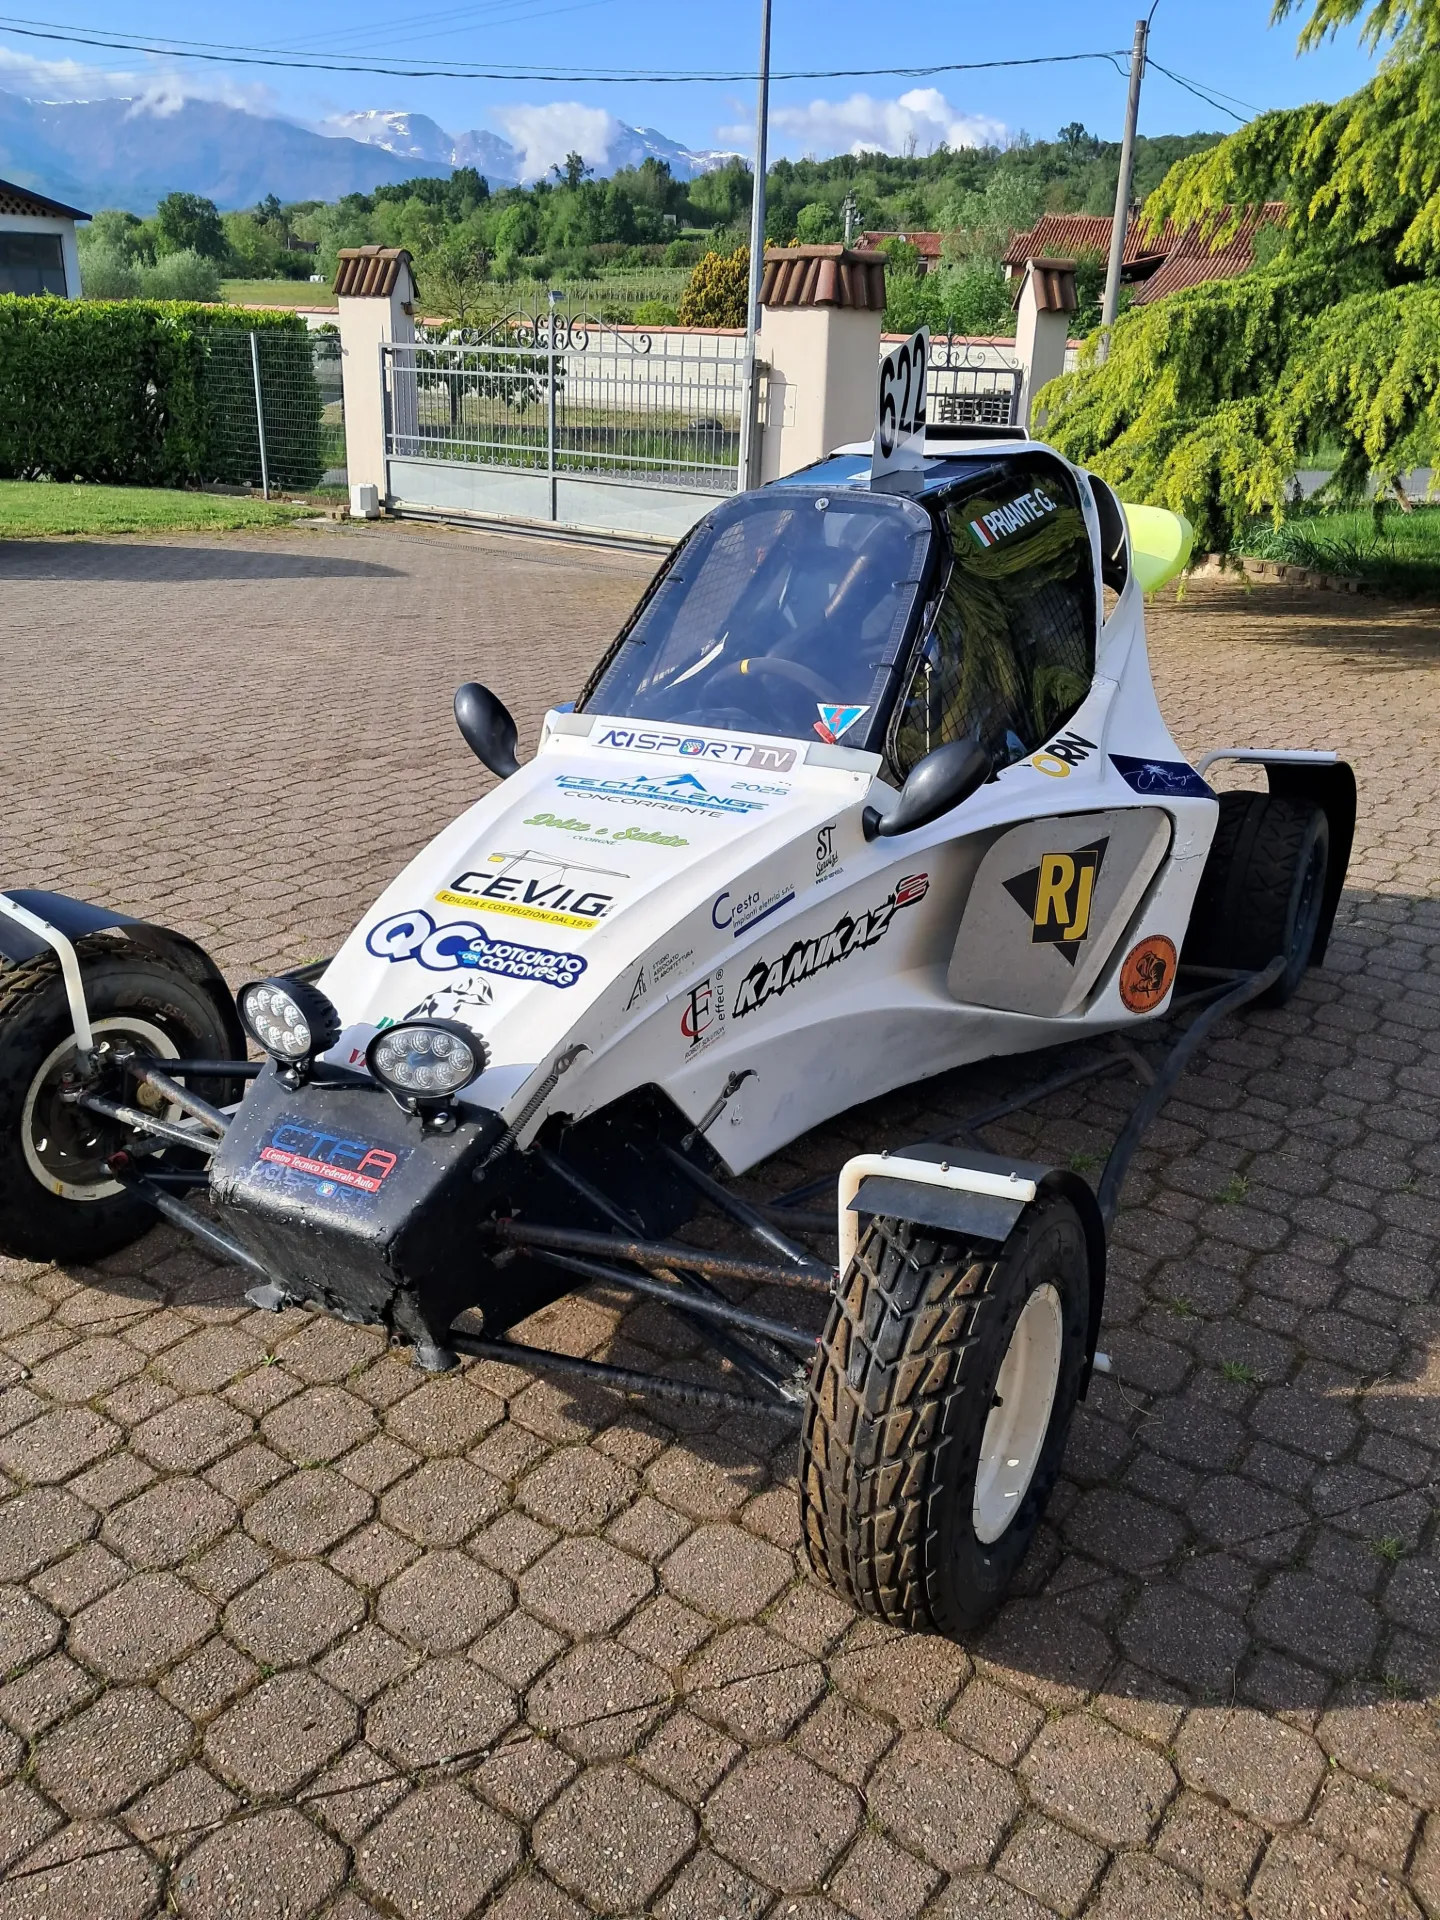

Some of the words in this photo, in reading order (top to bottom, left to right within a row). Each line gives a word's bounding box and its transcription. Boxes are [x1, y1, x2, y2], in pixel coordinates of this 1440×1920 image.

[879, 333, 926, 459] 622
[982, 495, 1044, 541] PRIANTE
[1036, 488, 1058, 512] G.
[757, 749, 792, 767] TV
[554, 775, 601, 786] ICE
[600, 780, 769, 810] CHALLENGE
[563, 790, 724, 818] CONCORRENTE
[730, 781, 790, 796] 2025
[523, 813, 591, 832] Dolce
[595, 827, 609, 835] e
[612, 826, 690, 847] Salato
[816, 823, 837, 861] ST
[441, 894, 480, 908] EDILIZIA
[487, 903, 551, 920] COSTRUZIONI
[551, 915, 568, 924] DAL
[570, 917, 594, 928] 1976
[450, 871, 614, 917] C.E.V.I.G.
[711, 891, 760, 930] Cresta
[732, 906, 758, 928] Impianti
[759, 890, 781, 911] elettrici
[1034, 854, 1095, 940] RJ
[367, 909, 484, 971] QC
[652, 953, 670, 970] STUDIO
[715, 984, 726, 1021] effeci
[266, 1149, 291, 1164] Centro
[291, 1156, 320, 1173] Tecnico
[319, 1164, 355, 1184] Federale
[353, 1176, 374, 1190] Auto
[271, 1124, 397, 1179] CTFA
